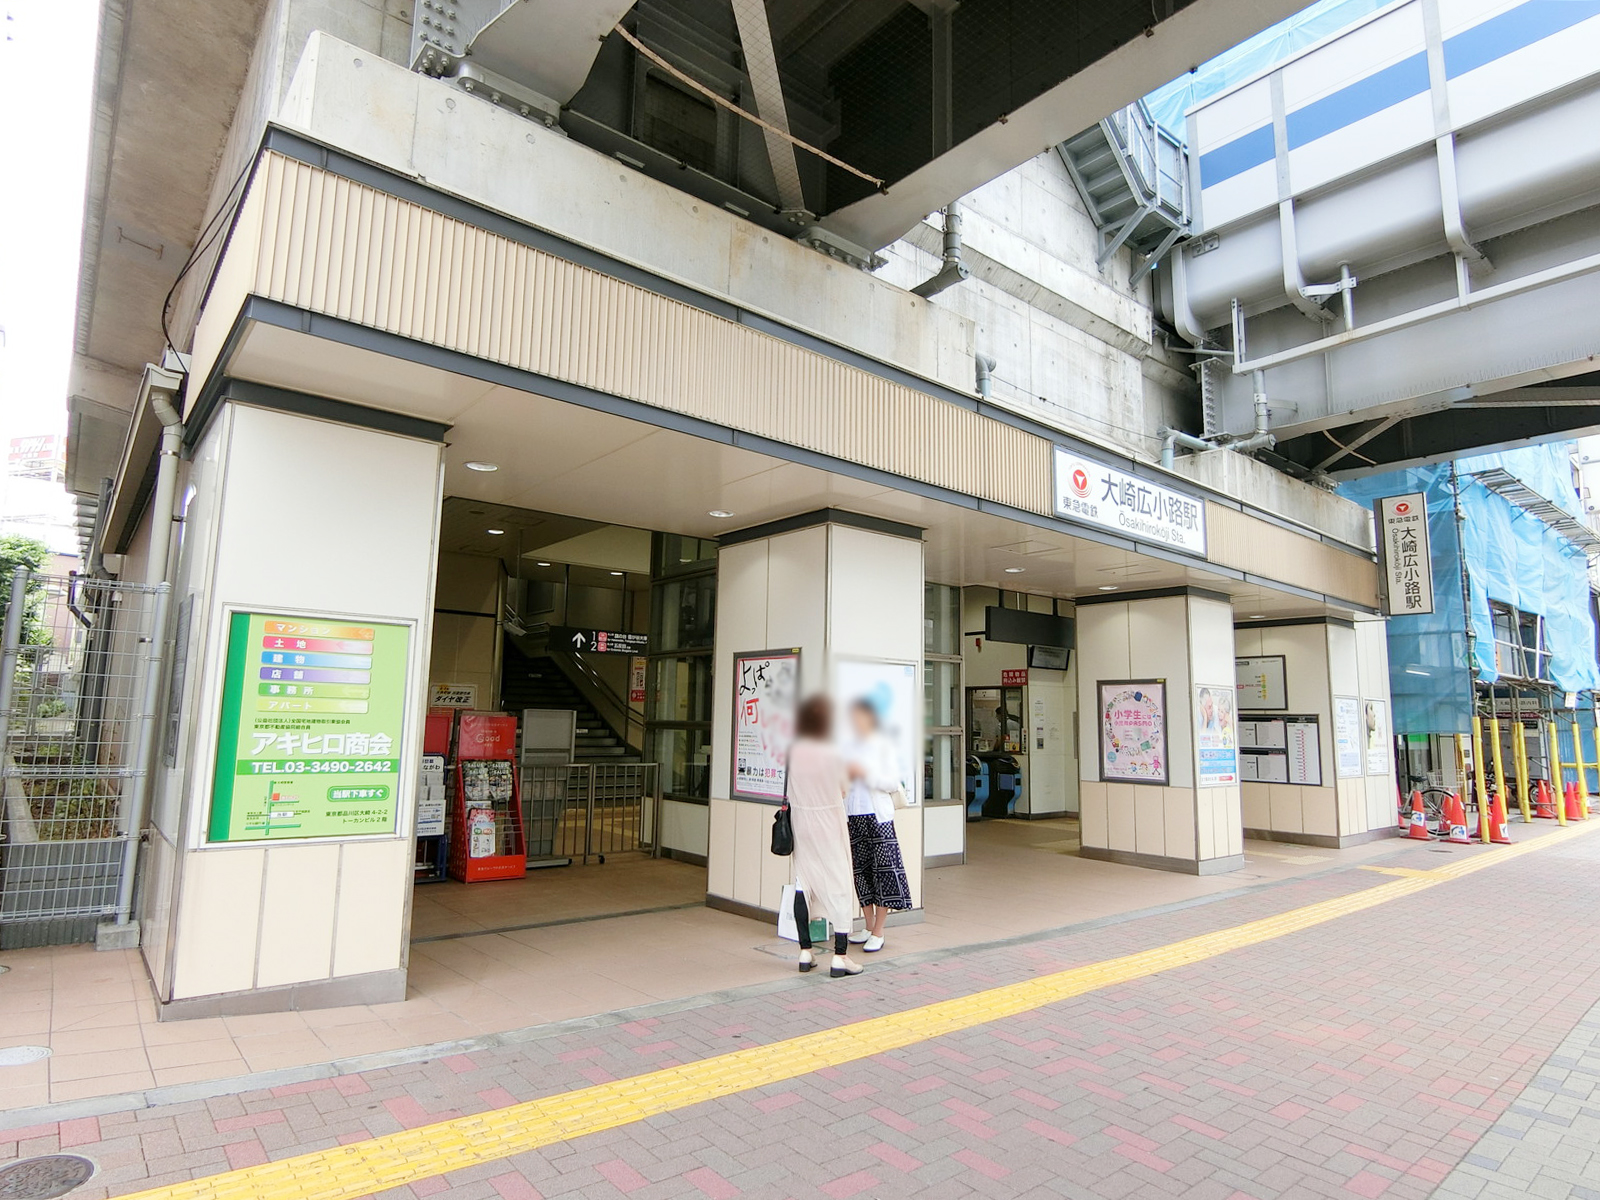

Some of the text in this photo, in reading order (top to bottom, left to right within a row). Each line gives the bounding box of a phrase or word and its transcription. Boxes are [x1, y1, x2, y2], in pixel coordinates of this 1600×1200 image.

[1063, 496, 1098, 518] 東急電鉄
[1101, 473, 1199, 532] 大崎広小路駅
[1388, 515, 1419, 524] 東急電鉄
[1171, 528, 1186, 544] Sta.
[1400, 526, 1422, 609] 大崎広小路駅
[276, 623, 330, 635] マンション
[592, 631, 596, 641] 1
[274, 639, 306, 649] 土地
[590, 642, 597, 651] 2
[272, 654, 305, 664] 建物
[271, 669, 304, 680] 店舗
[269, 684, 314, 696] 事務所
[434, 695, 472, 703] ダイヤ改正
[268, 701, 313, 711] アパート
[740, 698, 760, 726] 何
[1114, 709, 1152, 720] 小学生には
[251, 731, 394, 756] アキヒロ商会
[476, 733, 500, 743] Good
[252, 761, 391, 774] TEL.03-3490-2642
[746, 767, 785, 779] 暴力は犯罪で
[332, 789, 384, 799] 当駅下車すぐ
